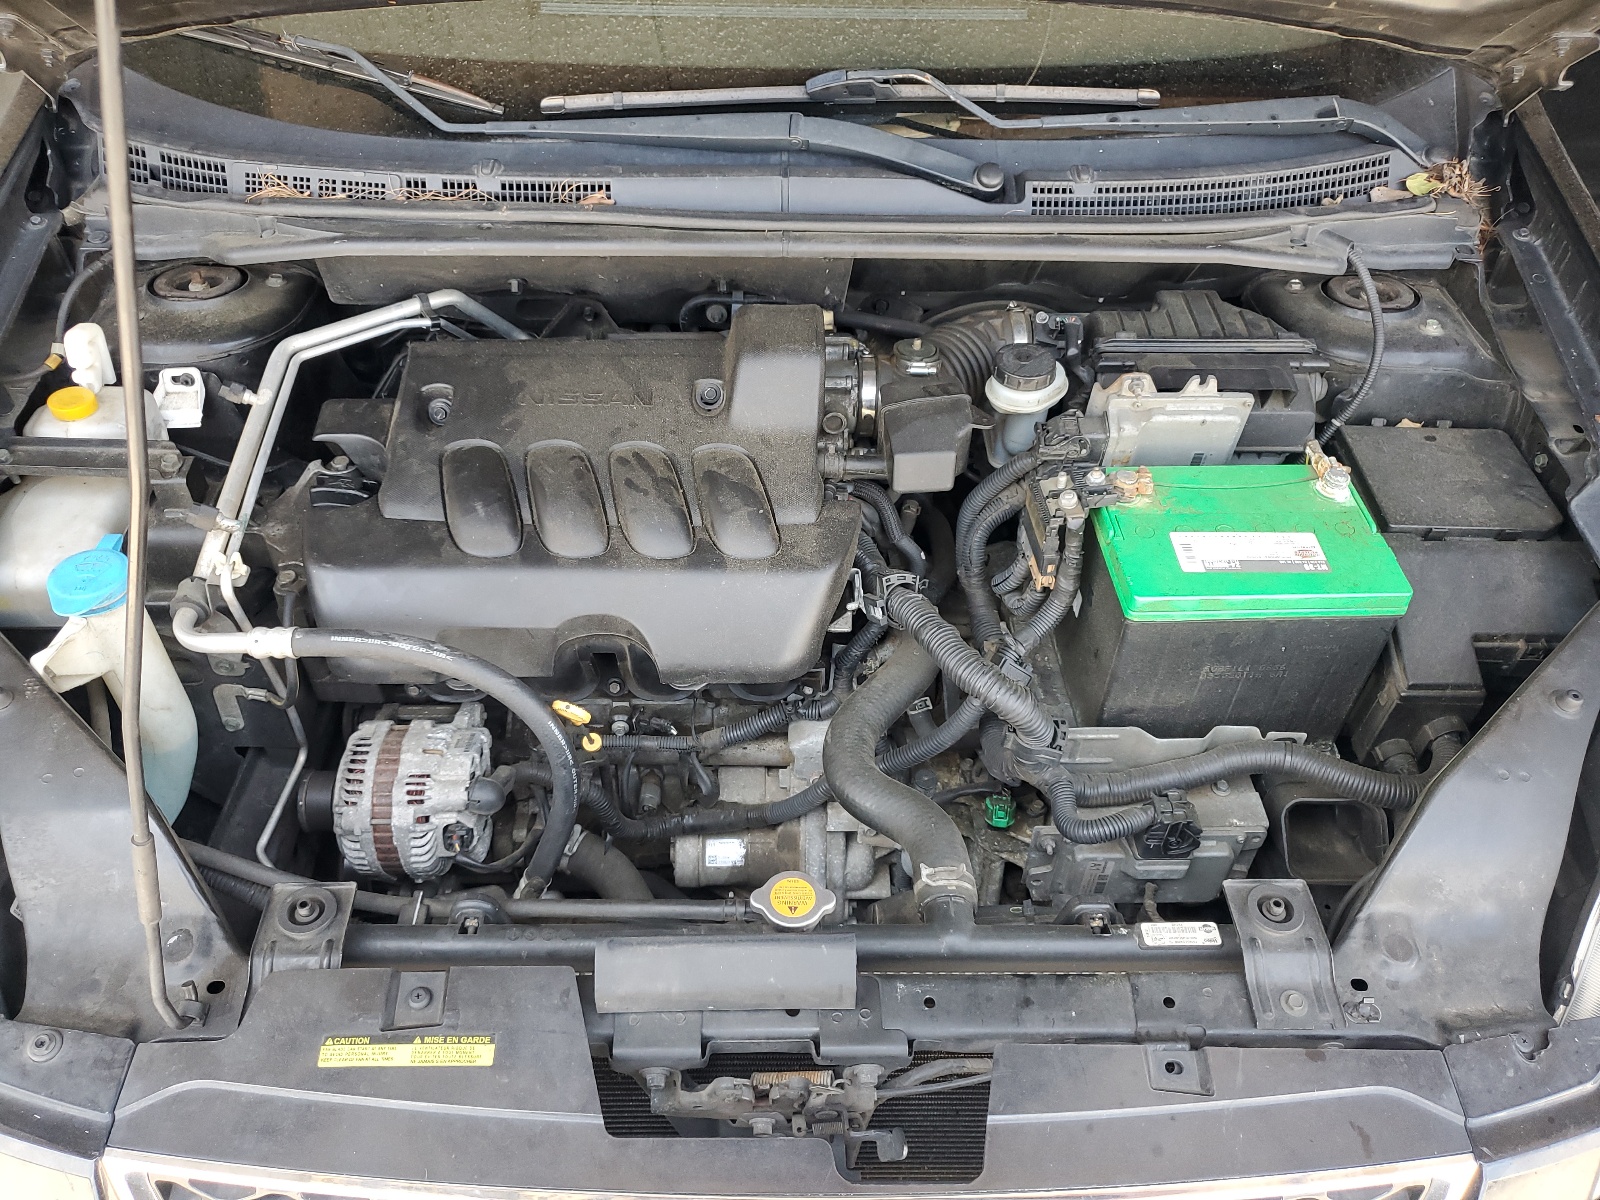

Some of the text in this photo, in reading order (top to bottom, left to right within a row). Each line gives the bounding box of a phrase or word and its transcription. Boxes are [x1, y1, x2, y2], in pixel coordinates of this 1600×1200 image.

[518, 391, 654, 407] NISSAN
[333, 1037, 370, 1045] CAUTION
[423, 1036, 491, 1044] MISE EN GARDE
